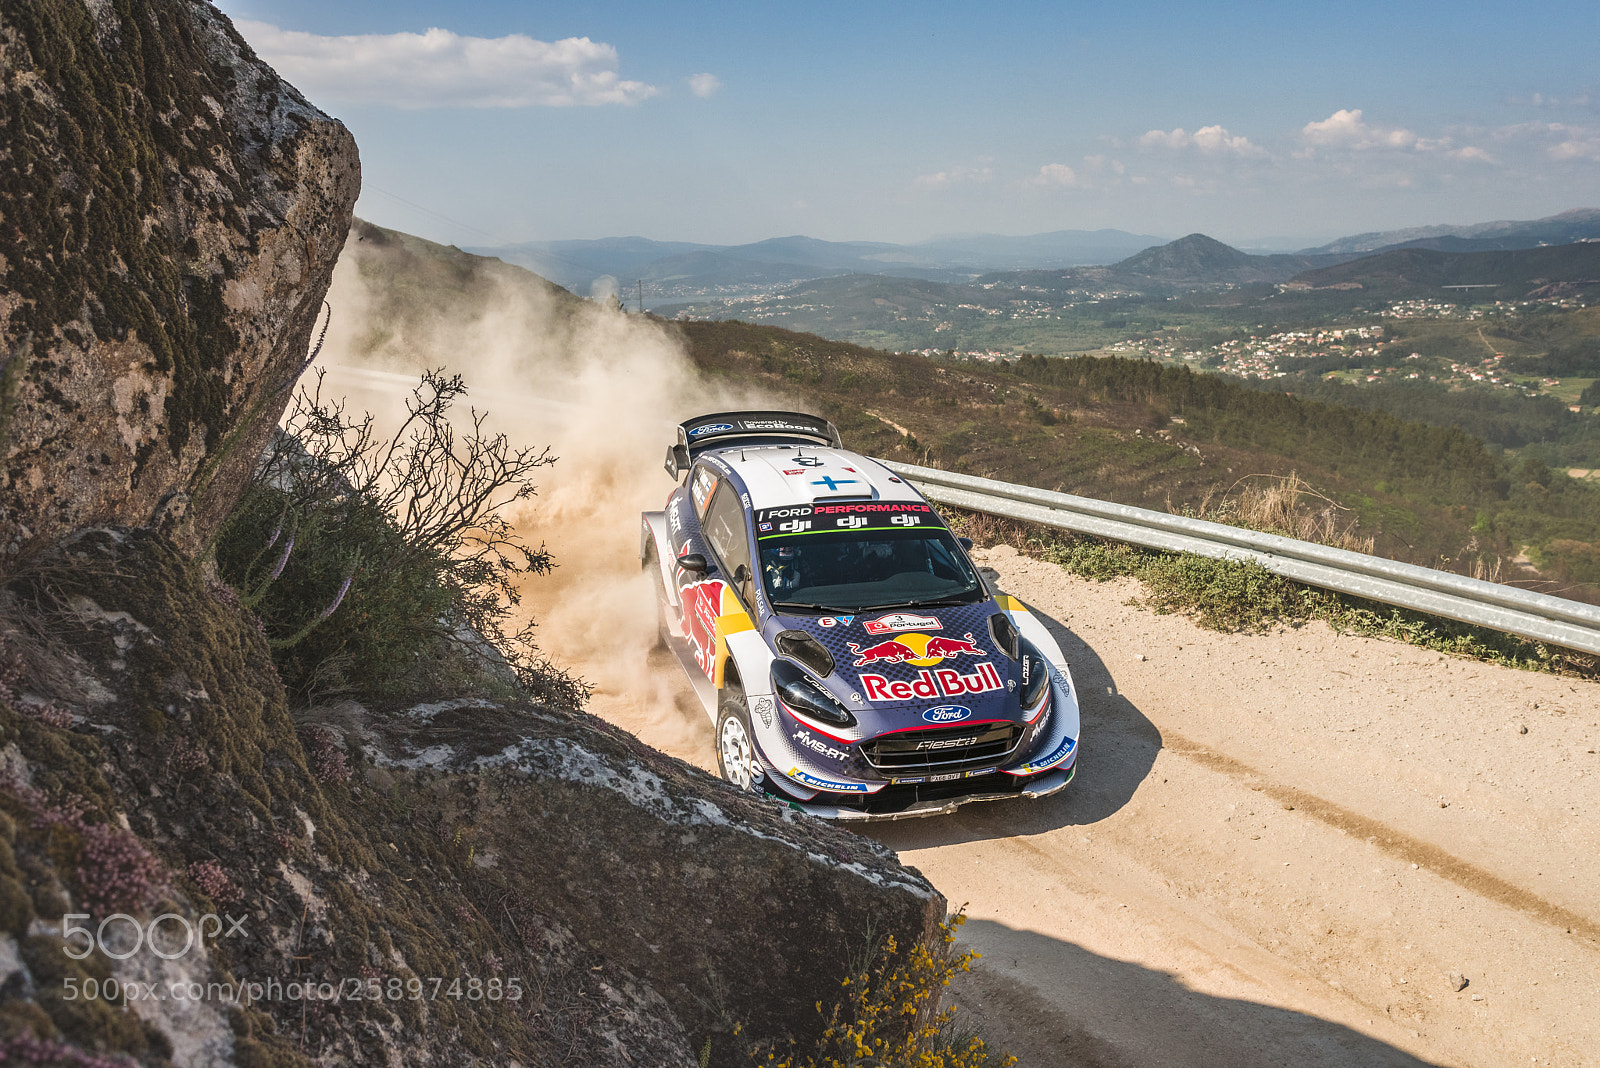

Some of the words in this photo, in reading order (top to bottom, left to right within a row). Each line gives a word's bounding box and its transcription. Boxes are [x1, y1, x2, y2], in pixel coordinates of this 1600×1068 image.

[768, 507, 812, 520] FORD
[814, 504, 931, 515] PERFORMANCE
[755, 588, 765, 617] PULSAR
[860, 670, 939, 701] Red
[936, 663, 1003, 697] Bull
[932, 707, 963, 721] Ford
[915, 737, 978, 750] Fiesta
[1039, 742, 1071, 767] MICHELIN
[806, 777, 859, 790] MICHELIN
